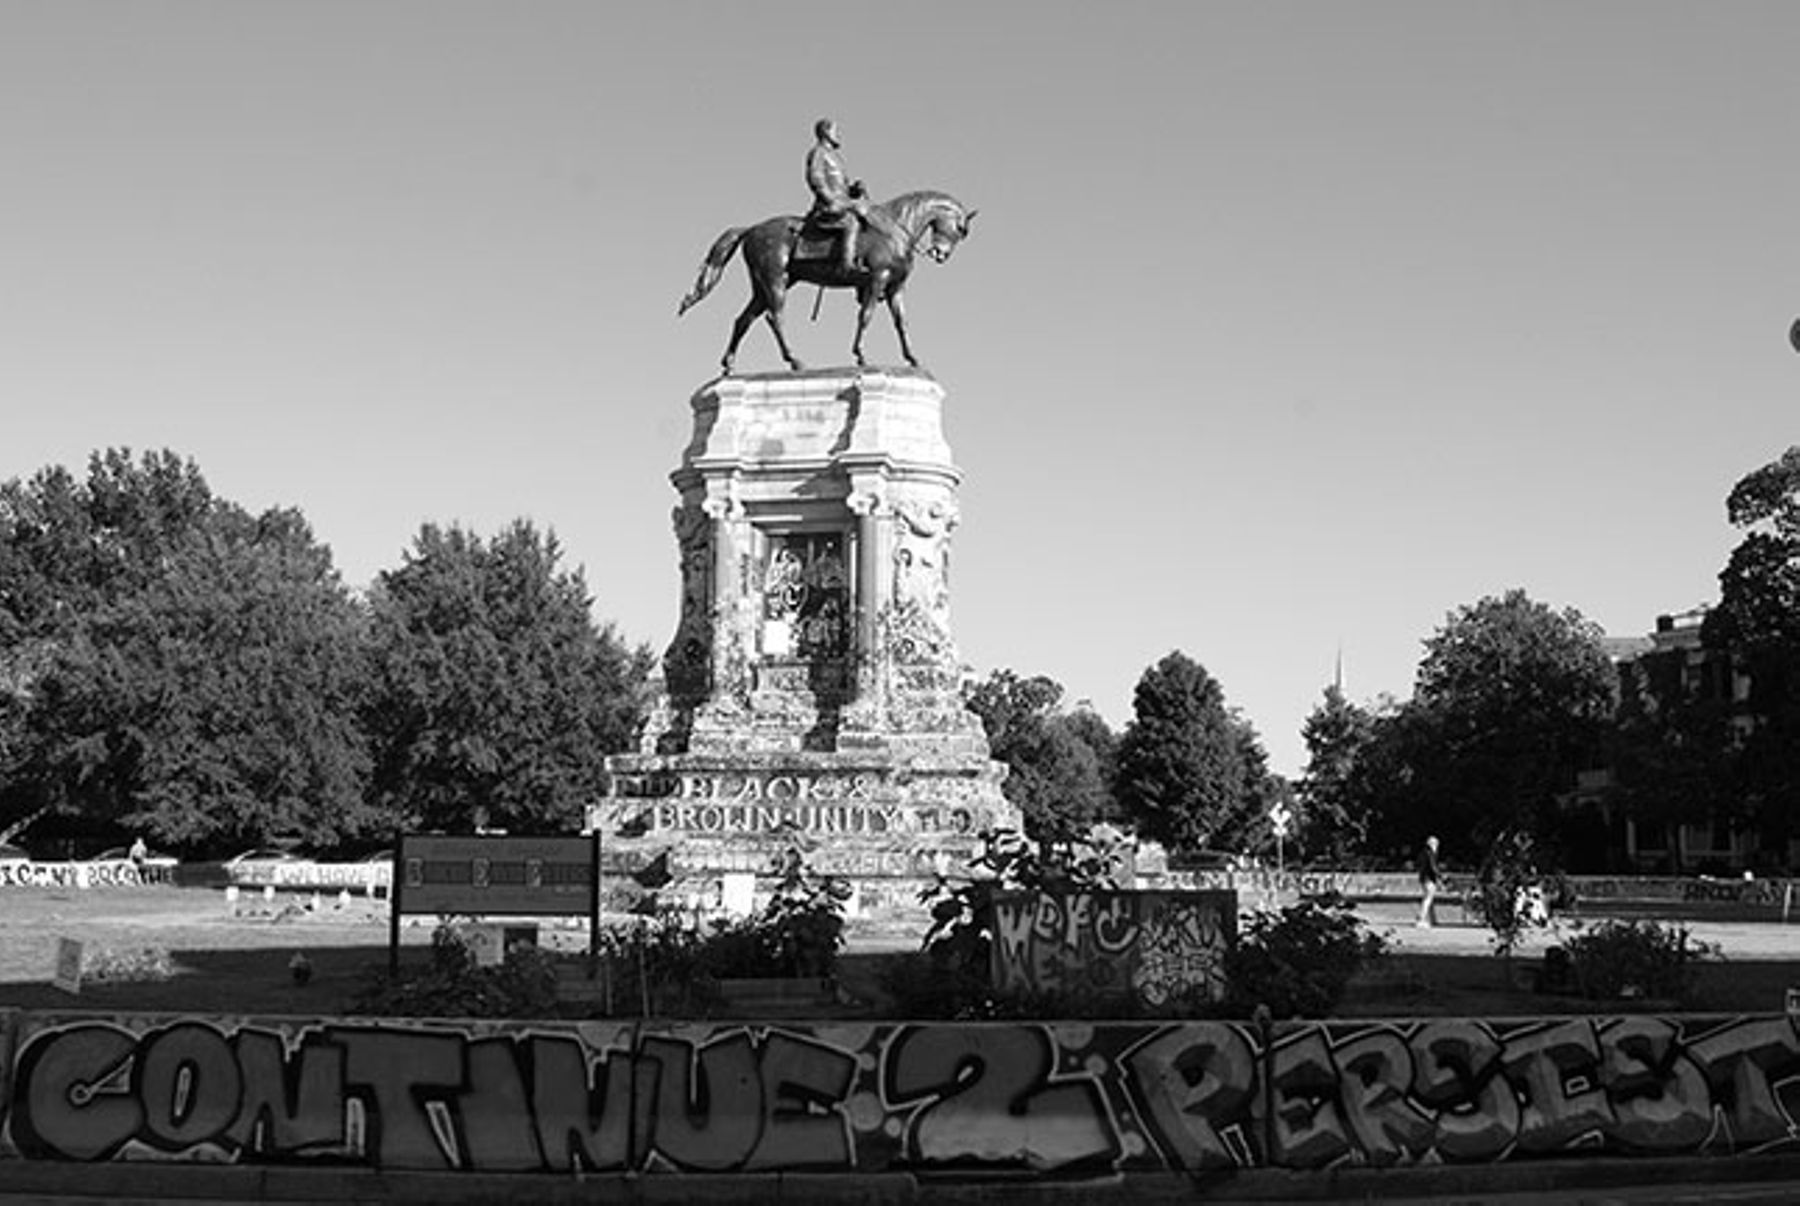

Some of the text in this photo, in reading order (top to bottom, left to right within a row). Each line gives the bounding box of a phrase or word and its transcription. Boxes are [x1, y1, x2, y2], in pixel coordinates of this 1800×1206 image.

[682, 775, 836, 800] BLACK
[849, 776, 874, 799] &
[653, 806, 782, 831] BROWN
[802, 806, 901, 832] UNITY
[17, 1016, 1800, 1174] CONTINUE 2 PERSIST
